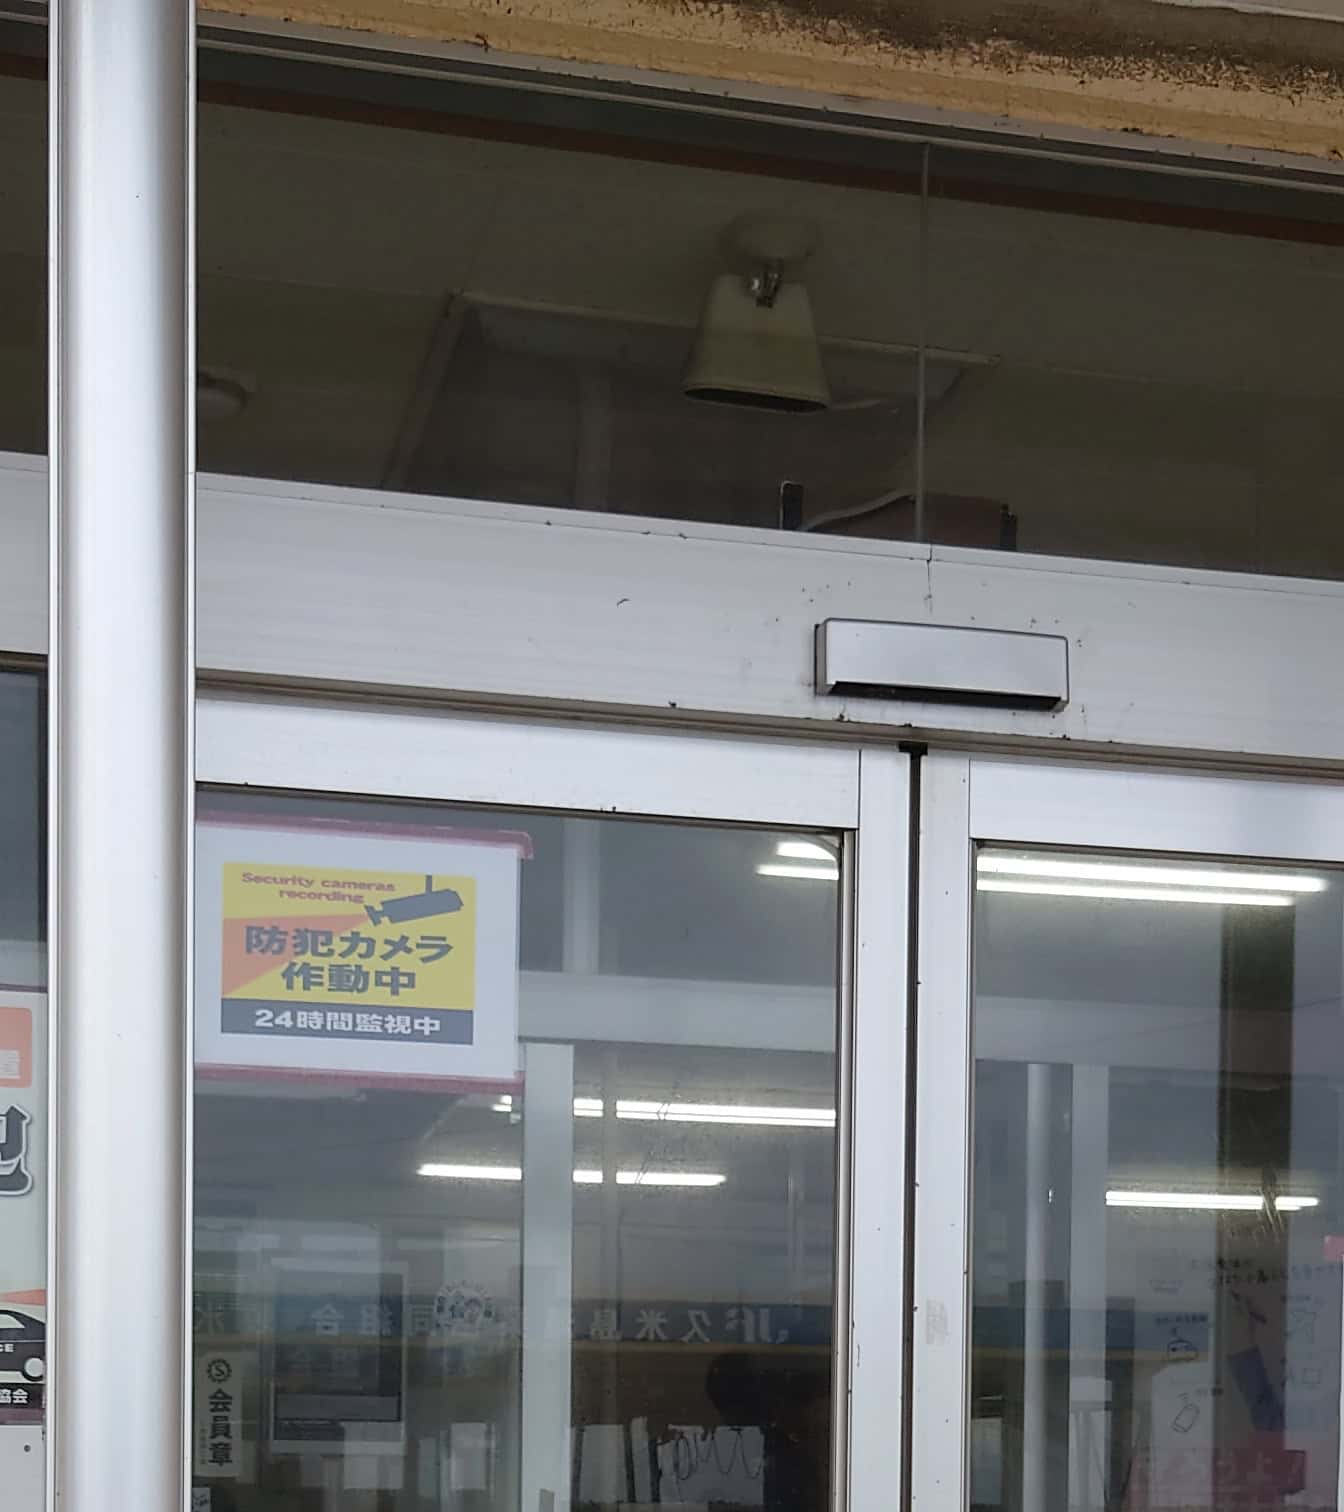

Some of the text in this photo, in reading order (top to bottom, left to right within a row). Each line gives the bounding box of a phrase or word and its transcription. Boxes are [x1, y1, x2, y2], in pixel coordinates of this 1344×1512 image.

[242, 872, 395, 892] Security cameras
[279, 889, 364, 904] recording
[245, 926, 454, 964] 防犯カメラ
[282, 962, 416, 996] 作動中
[256, 1010, 440, 1036] 24時間監視中
[208, 1387, 233, 1466] 会員章
